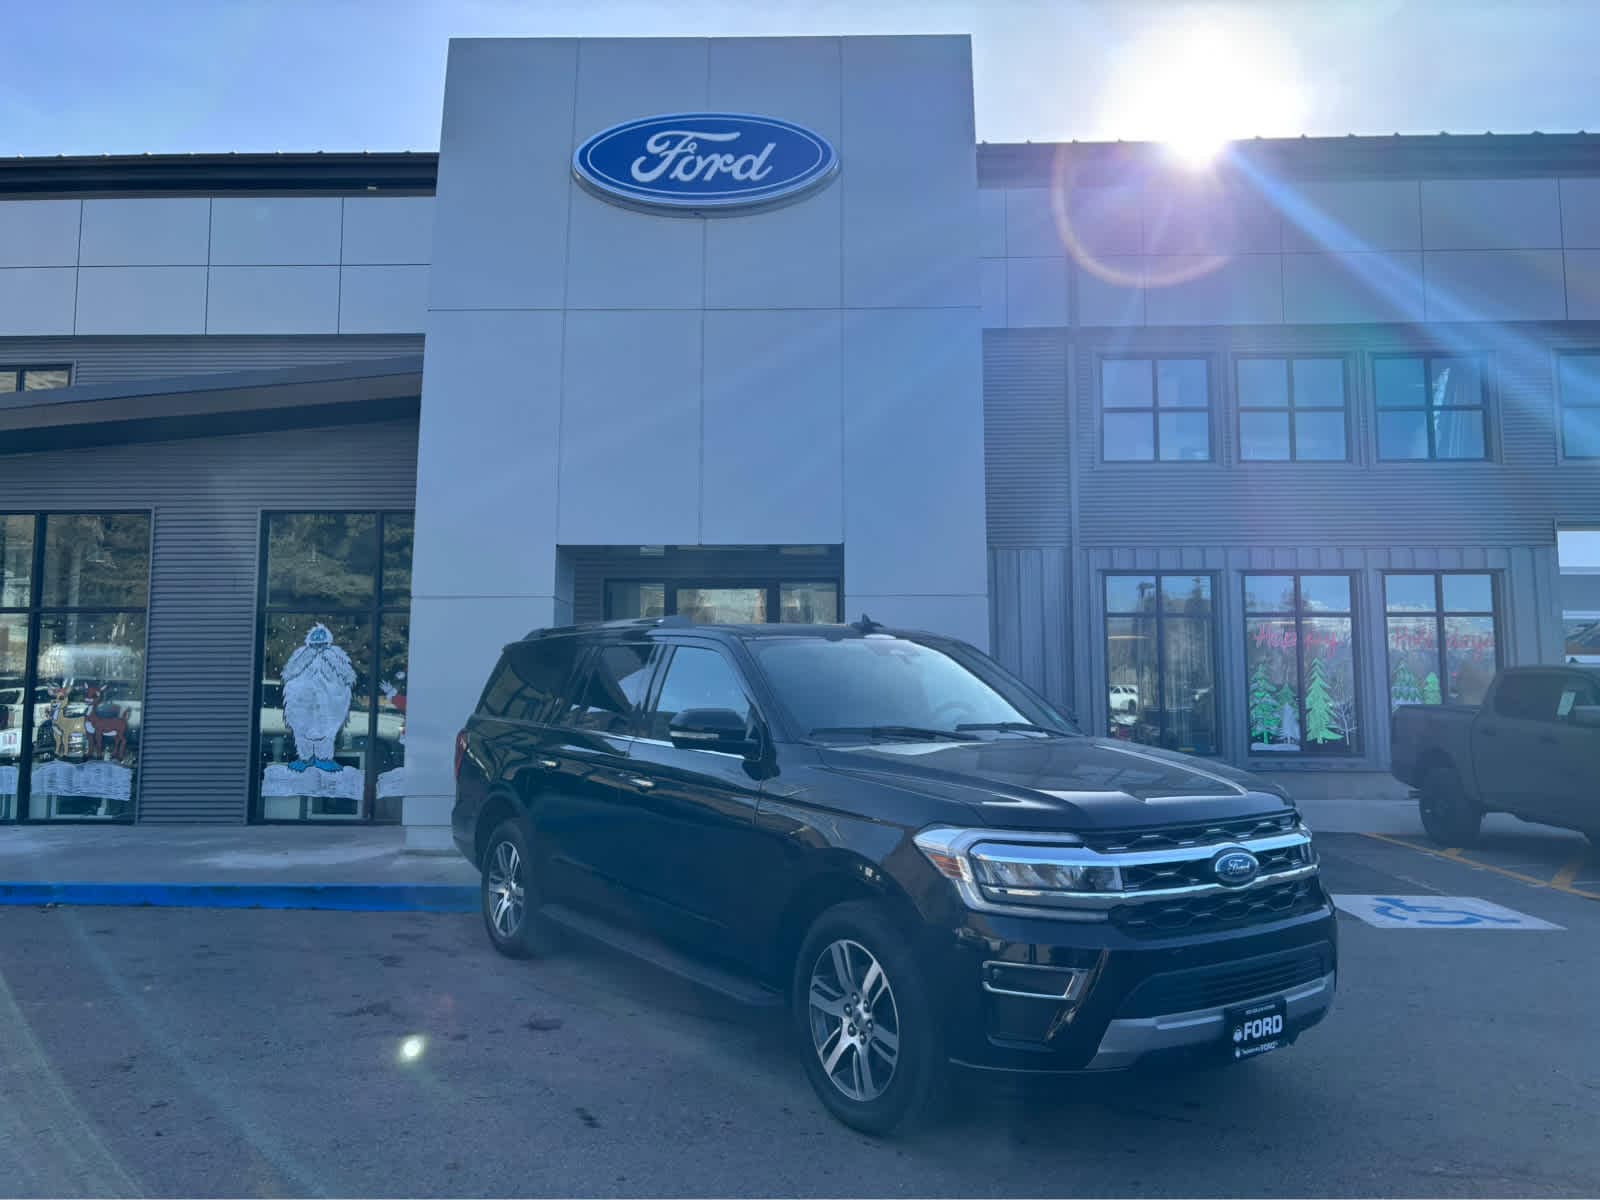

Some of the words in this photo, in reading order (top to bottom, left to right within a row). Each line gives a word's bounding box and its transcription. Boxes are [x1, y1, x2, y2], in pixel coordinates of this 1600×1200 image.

[631, 130, 777, 183] Ford
[1227, 859, 1250, 875] Ford
[1243, 1014, 1283, 1041] FORD
